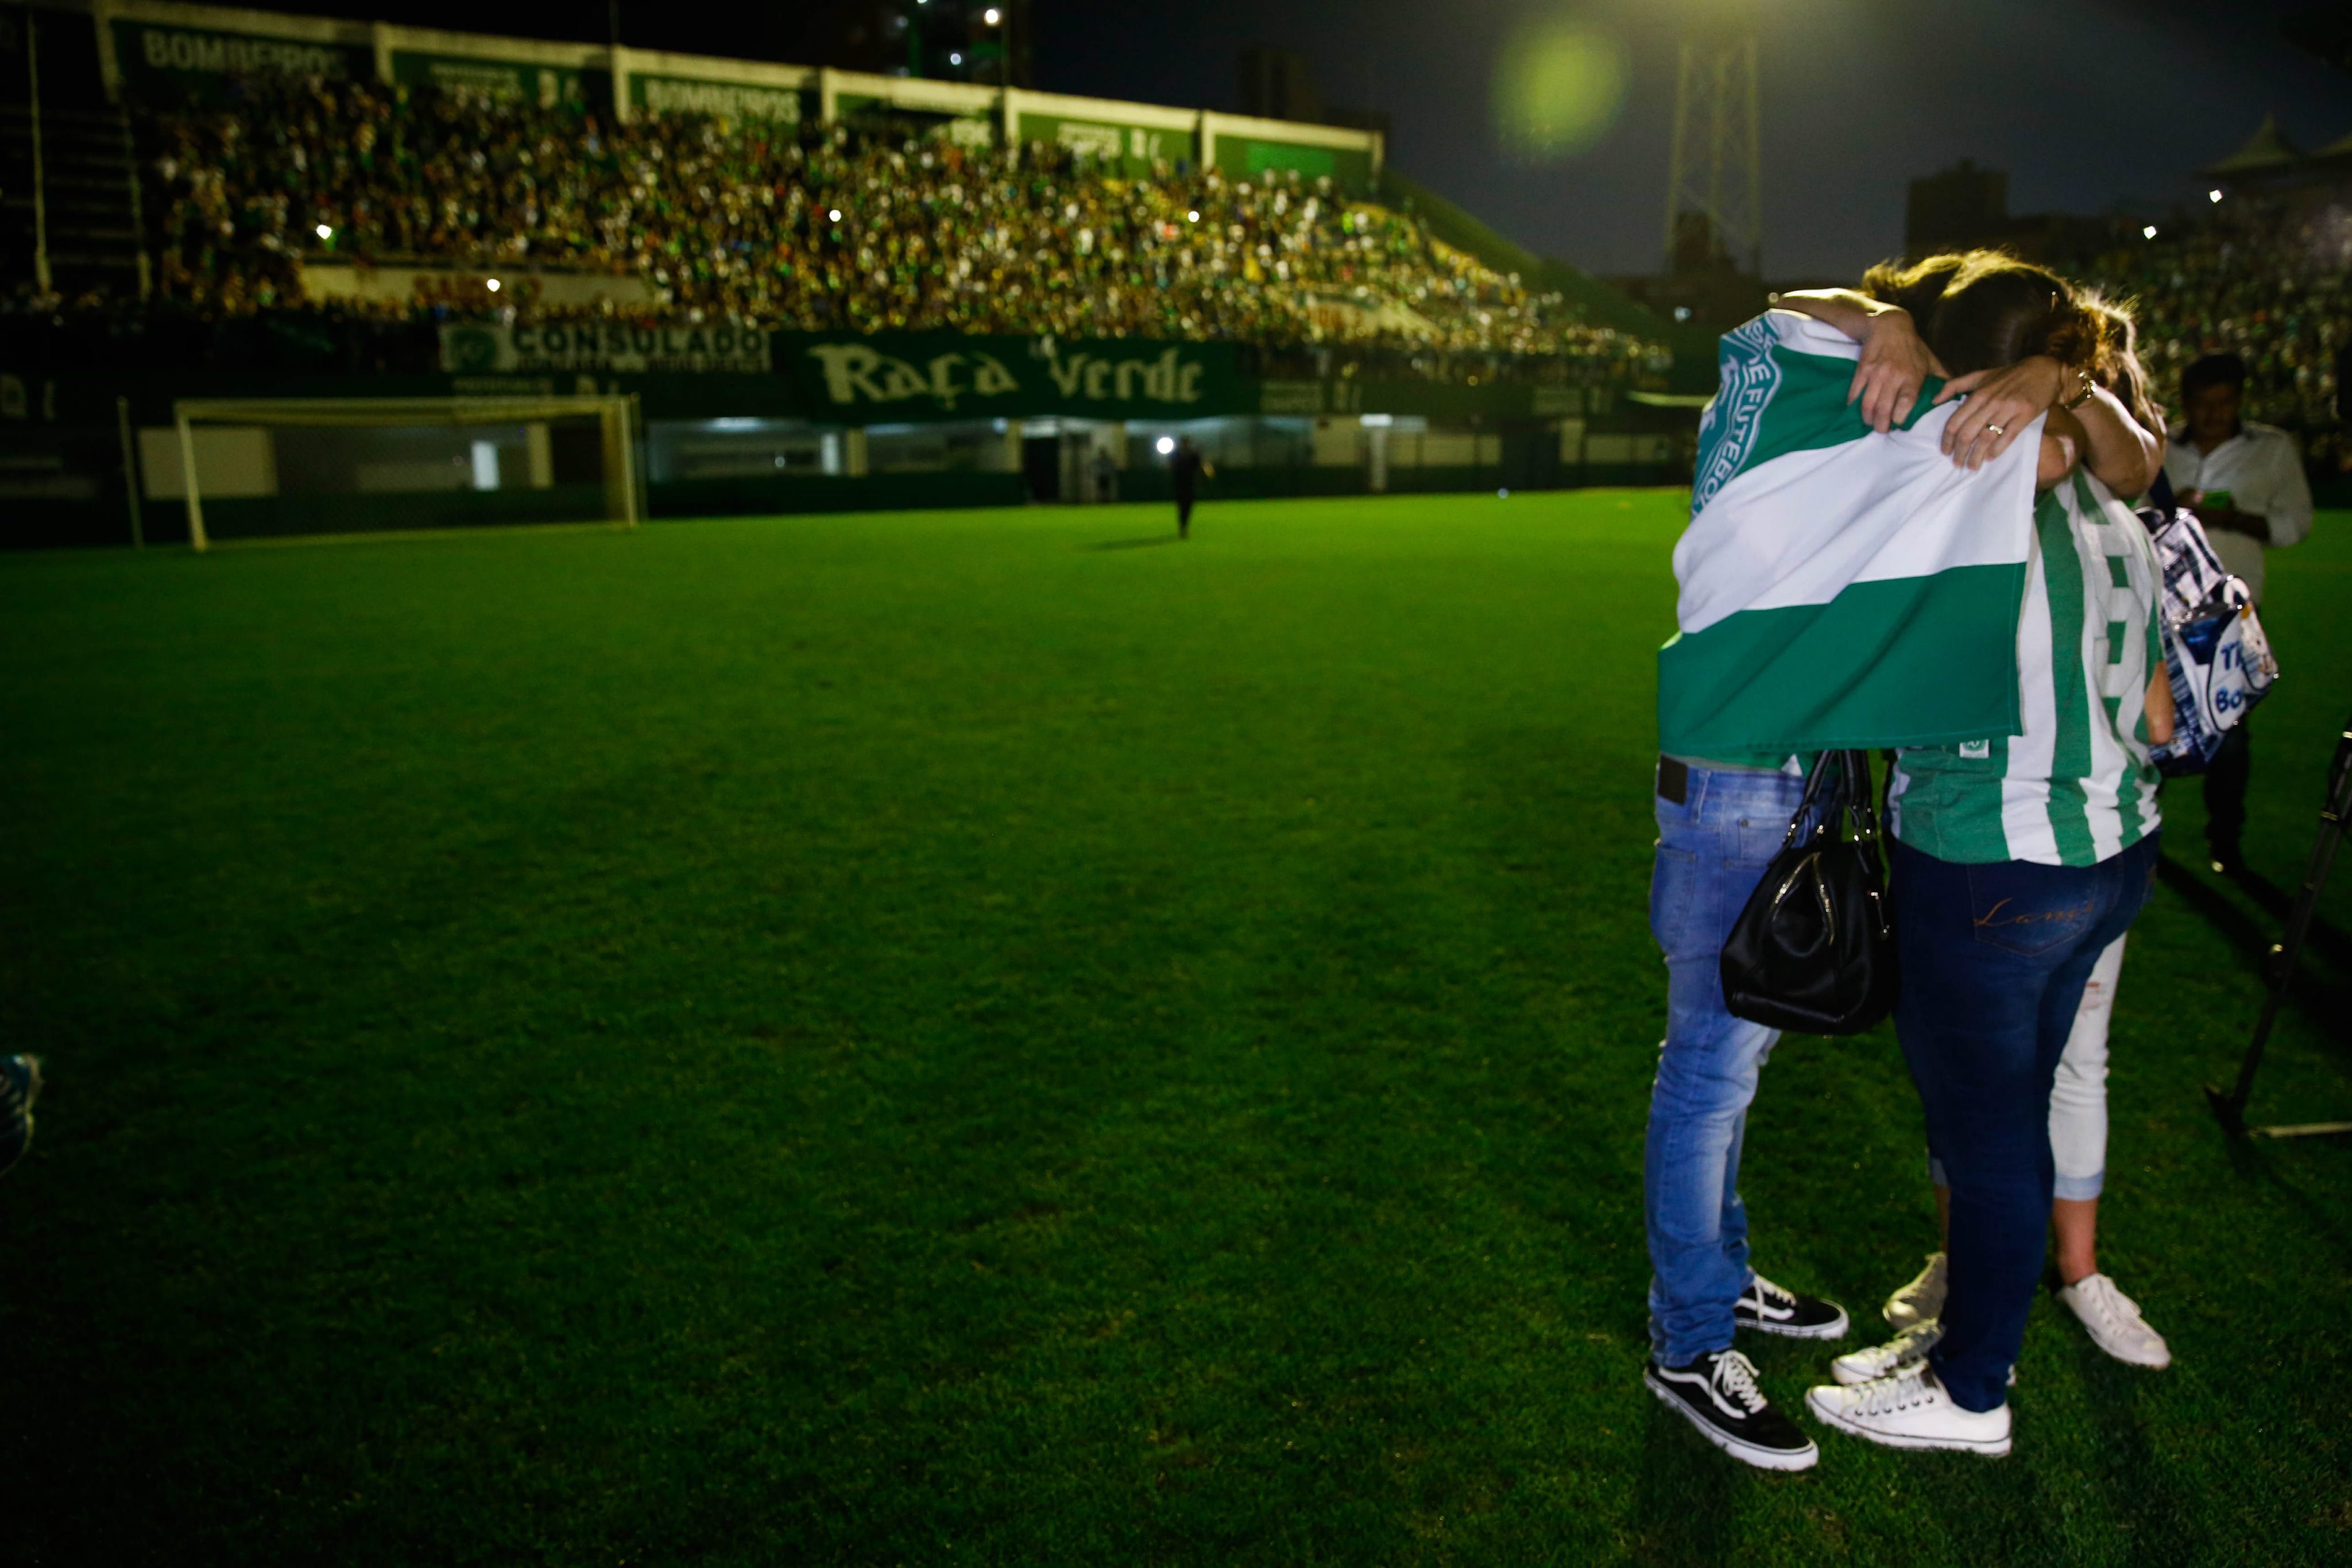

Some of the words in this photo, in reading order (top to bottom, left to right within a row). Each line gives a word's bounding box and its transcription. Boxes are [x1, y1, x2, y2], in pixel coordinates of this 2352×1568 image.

[512, 324, 763, 355] CONSULADO
[806, 342, 1022, 412] Raça
[1046, 346, 1206, 404] Verde
